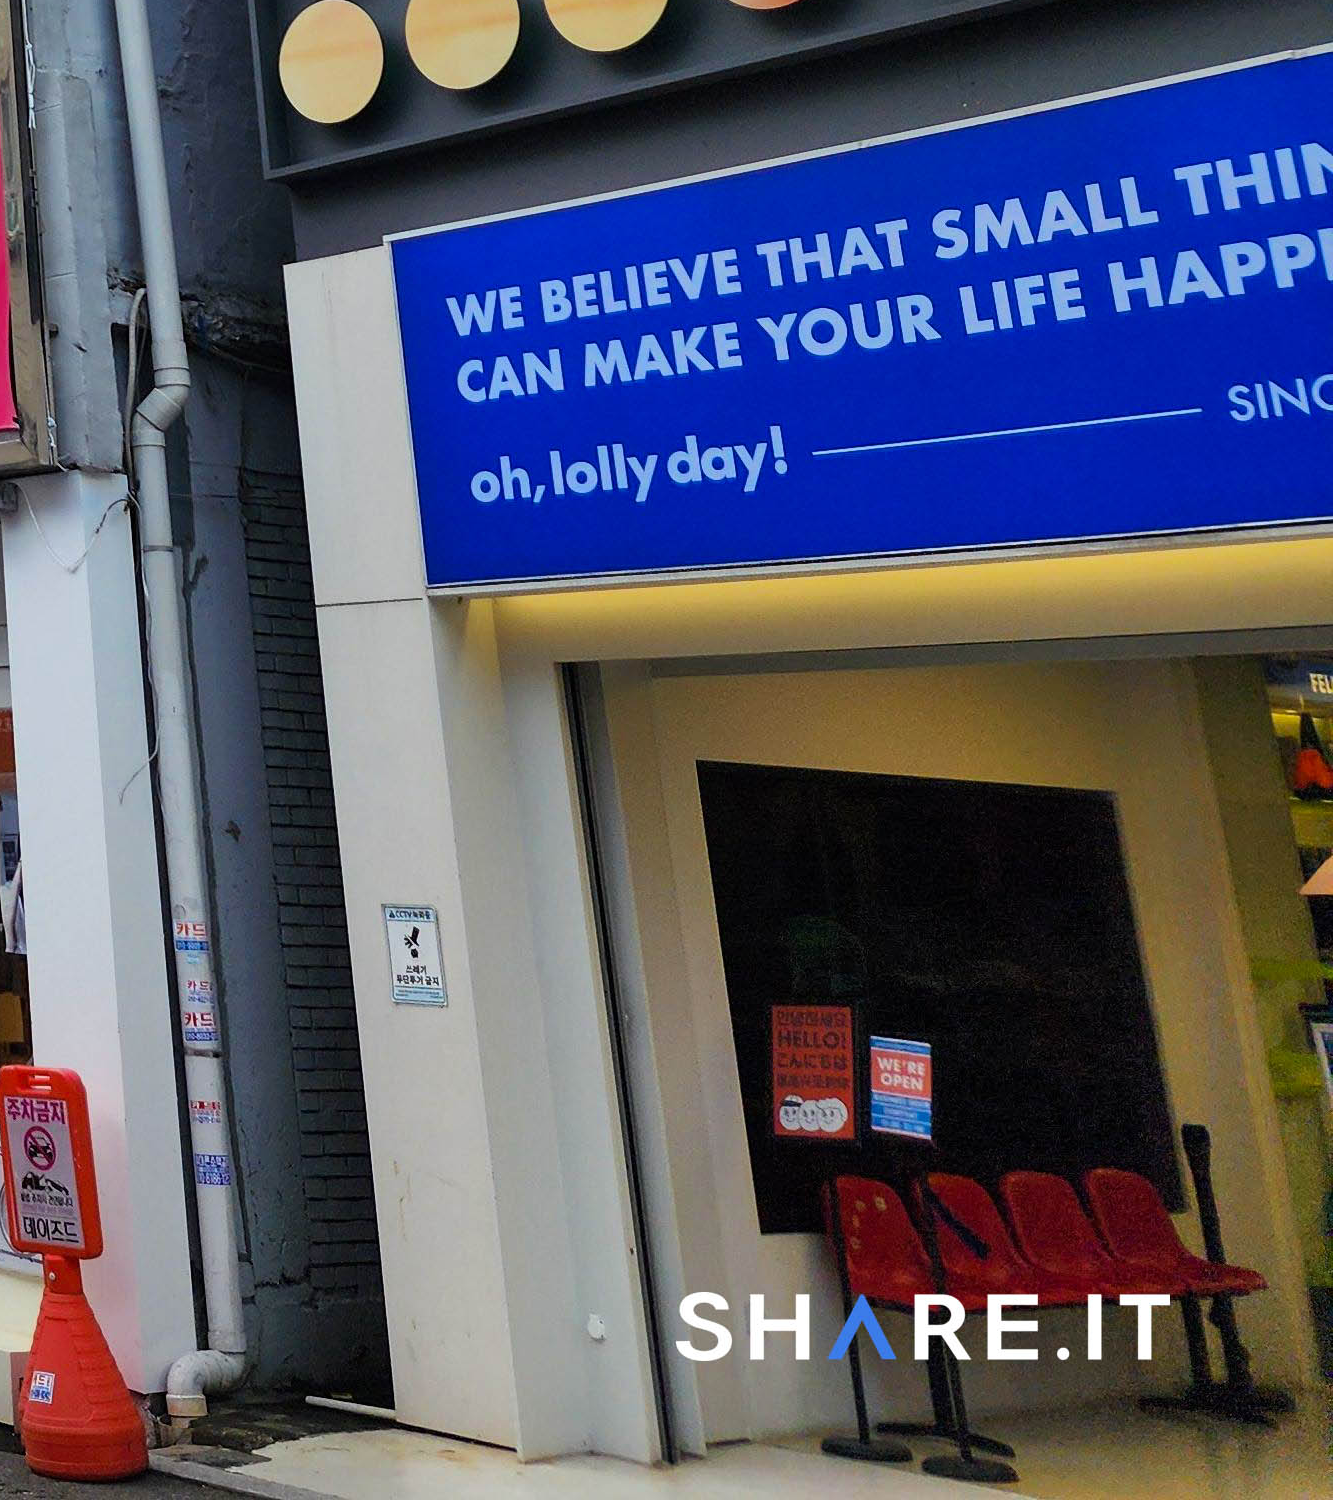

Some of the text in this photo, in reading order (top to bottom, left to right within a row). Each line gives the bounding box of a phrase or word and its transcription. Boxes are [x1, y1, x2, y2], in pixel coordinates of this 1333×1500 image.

[445, 286, 524, 338] WE
[540, 248, 741, 324] BELIEVE
[756, 218, 909, 284] THAT
[932, 176, 1160, 260] SMALL
[455, 348, 565, 405] CAN
[582, 320, 744, 389] MAKE
[756, 292, 942, 363] YOUR
[957, 267, 1087, 337] LIFE
[667, 425, 789, 494] day!
[395, 910, 412, 919] CCTV
[176, 923, 207, 937] 카드
[777, 1029, 846, 1049] HELLO!
[877, 1056, 926, 1077] WE'RE
[880, 1073, 924, 1092] OPEN
[7, 1098, 66, 1125] 주차금지
[22, 1216, 80, 1244] 데이즈드
